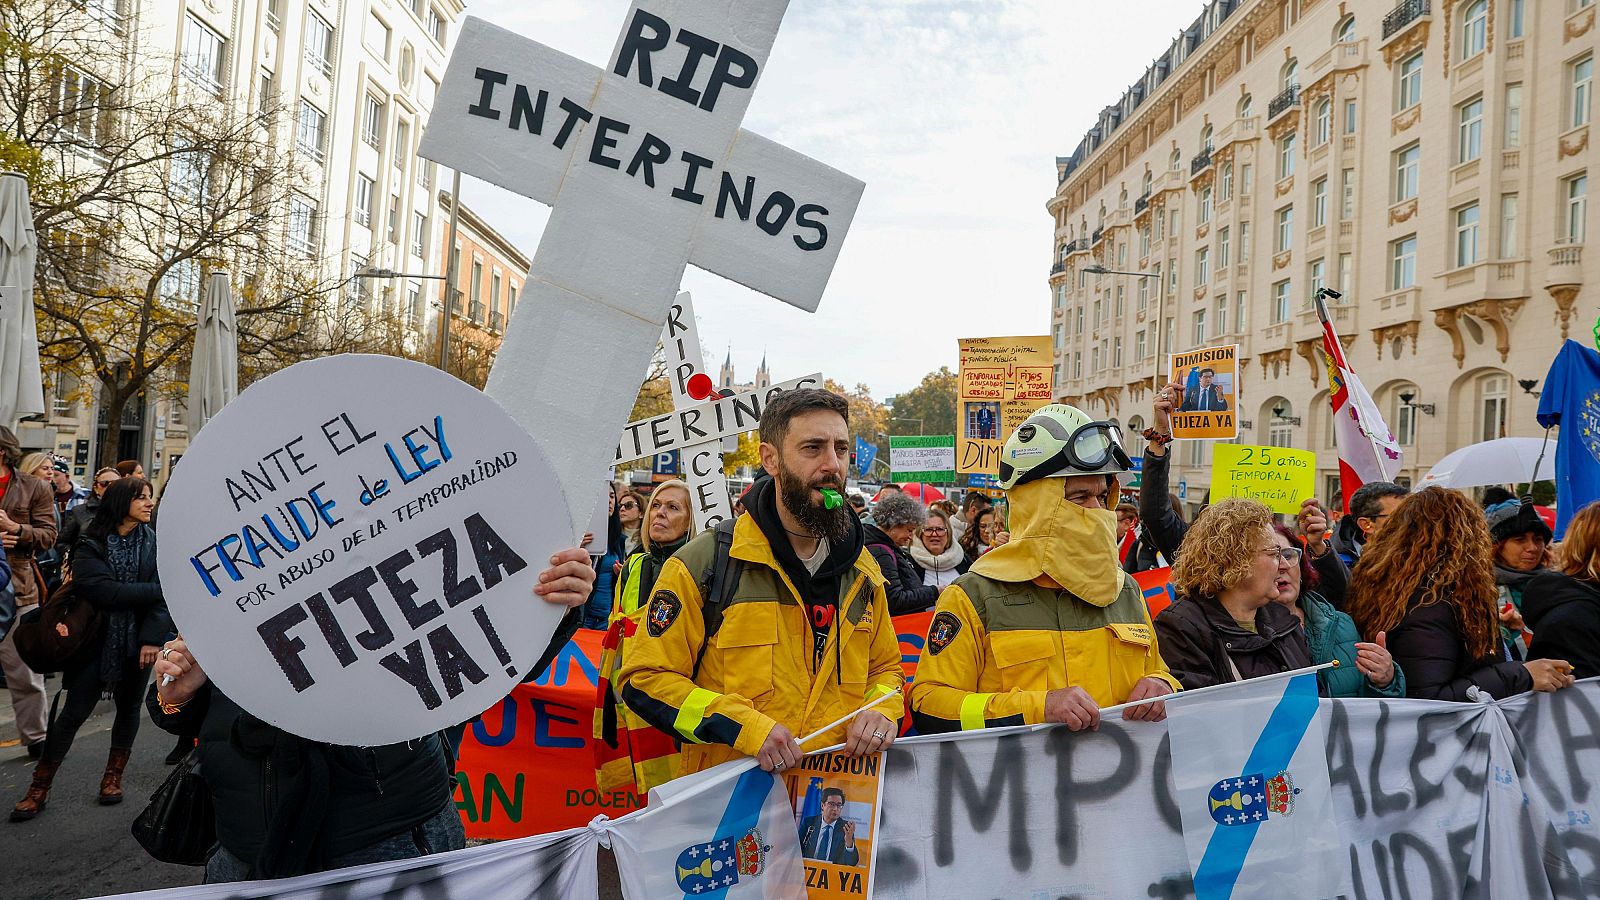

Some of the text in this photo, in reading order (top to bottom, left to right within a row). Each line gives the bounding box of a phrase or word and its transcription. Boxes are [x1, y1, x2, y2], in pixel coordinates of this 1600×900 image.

[613, 8, 759, 112] RIP
[468, 67, 829, 251] INTERINOS
[667, 304, 695, 396] RIP
[1175, 347, 1234, 368] DIMISIÓN
[224, 412, 377, 511] ANTE EL
[616, 378, 817, 460] TERIN
[656, 452, 673, 473] P
[1173, 414, 1233, 429] FIJEZA YA
[1236, 448, 1307, 468] 25 años
[189, 415, 453, 597] FRAUDE de LEY
[1229, 469, 1291, 481] TEMPORAL
[236, 582, 276, 613] POR
[277, 548, 336, 590] ABUSO
[342, 533, 364, 553] DE
[368, 519, 389, 540] LA
[256, 511, 528, 694] FIJEZA
[378, 604, 519, 711] YA!
[838, 870, 863, 894] YA
